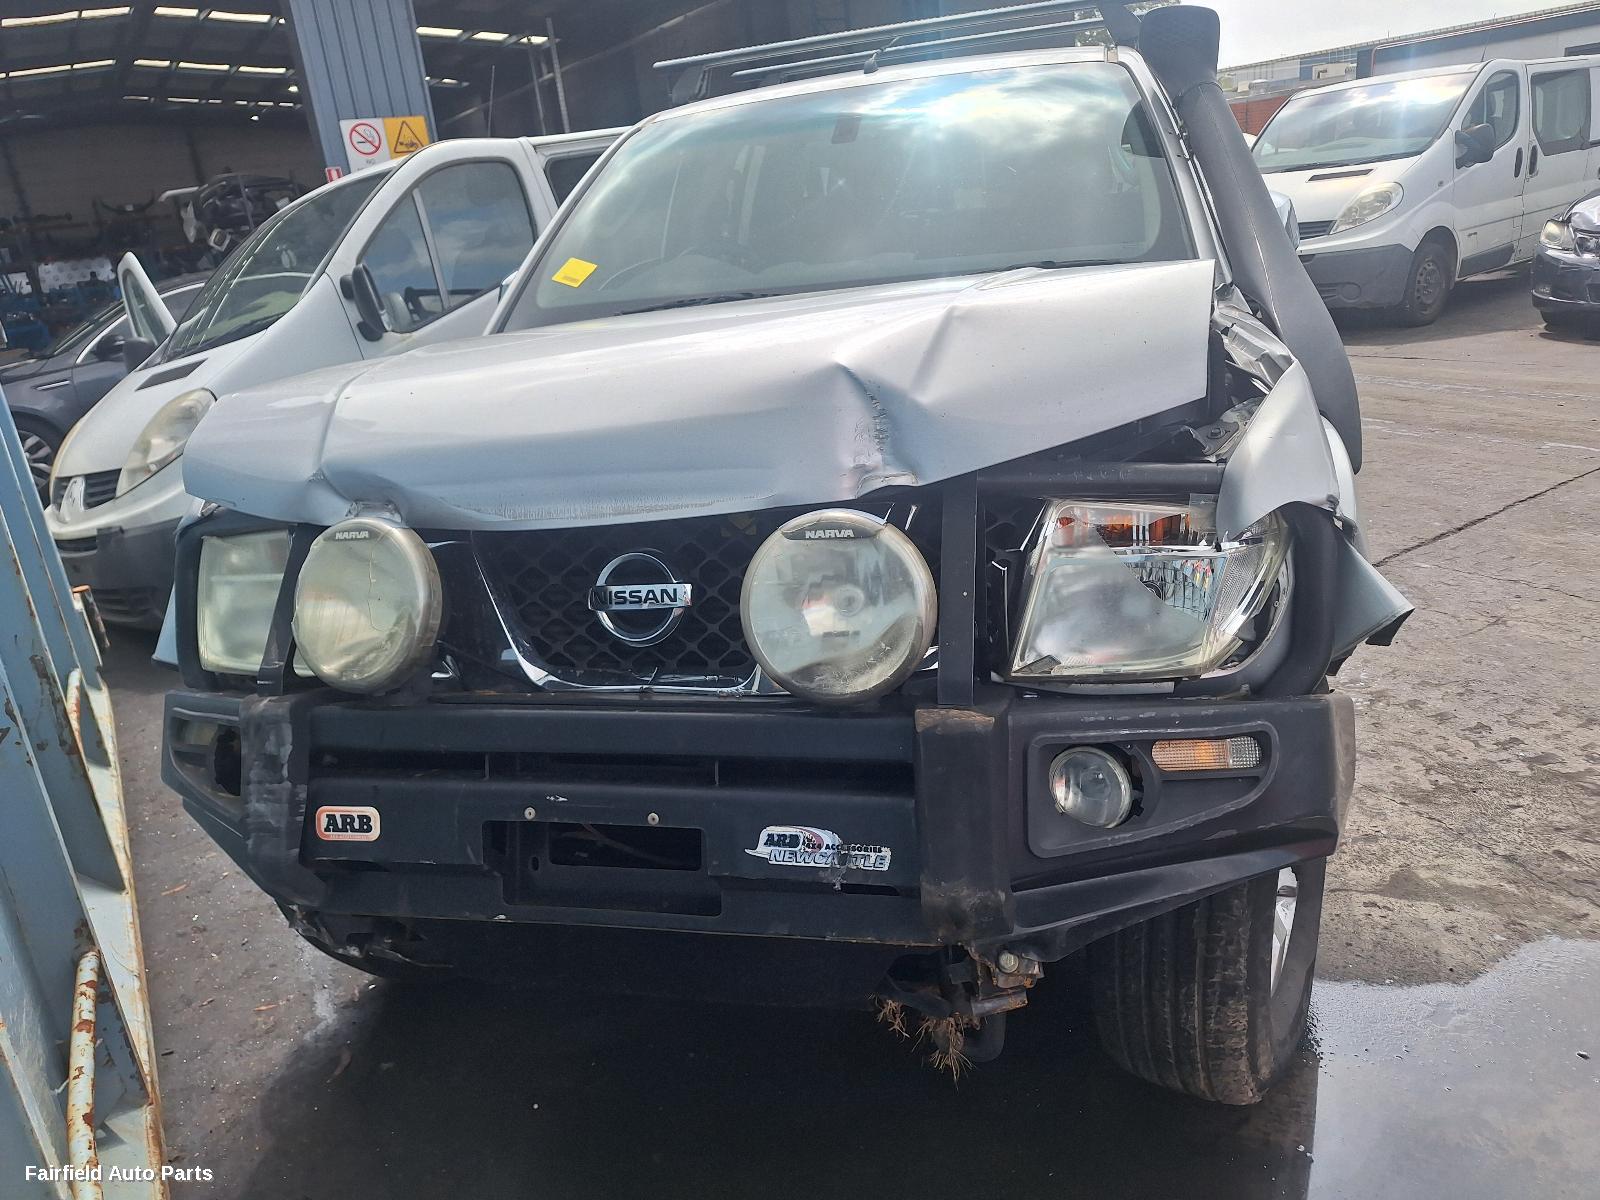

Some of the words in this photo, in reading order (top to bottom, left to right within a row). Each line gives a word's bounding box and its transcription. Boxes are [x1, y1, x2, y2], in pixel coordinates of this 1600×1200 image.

[335, 531, 369, 540] NARVA
[805, 529, 854, 539] NARVA
[592, 588, 677, 605] NISSAN
[324, 813, 373, 833] ARB
[769, 849, 887, 869] NEWCATLE
